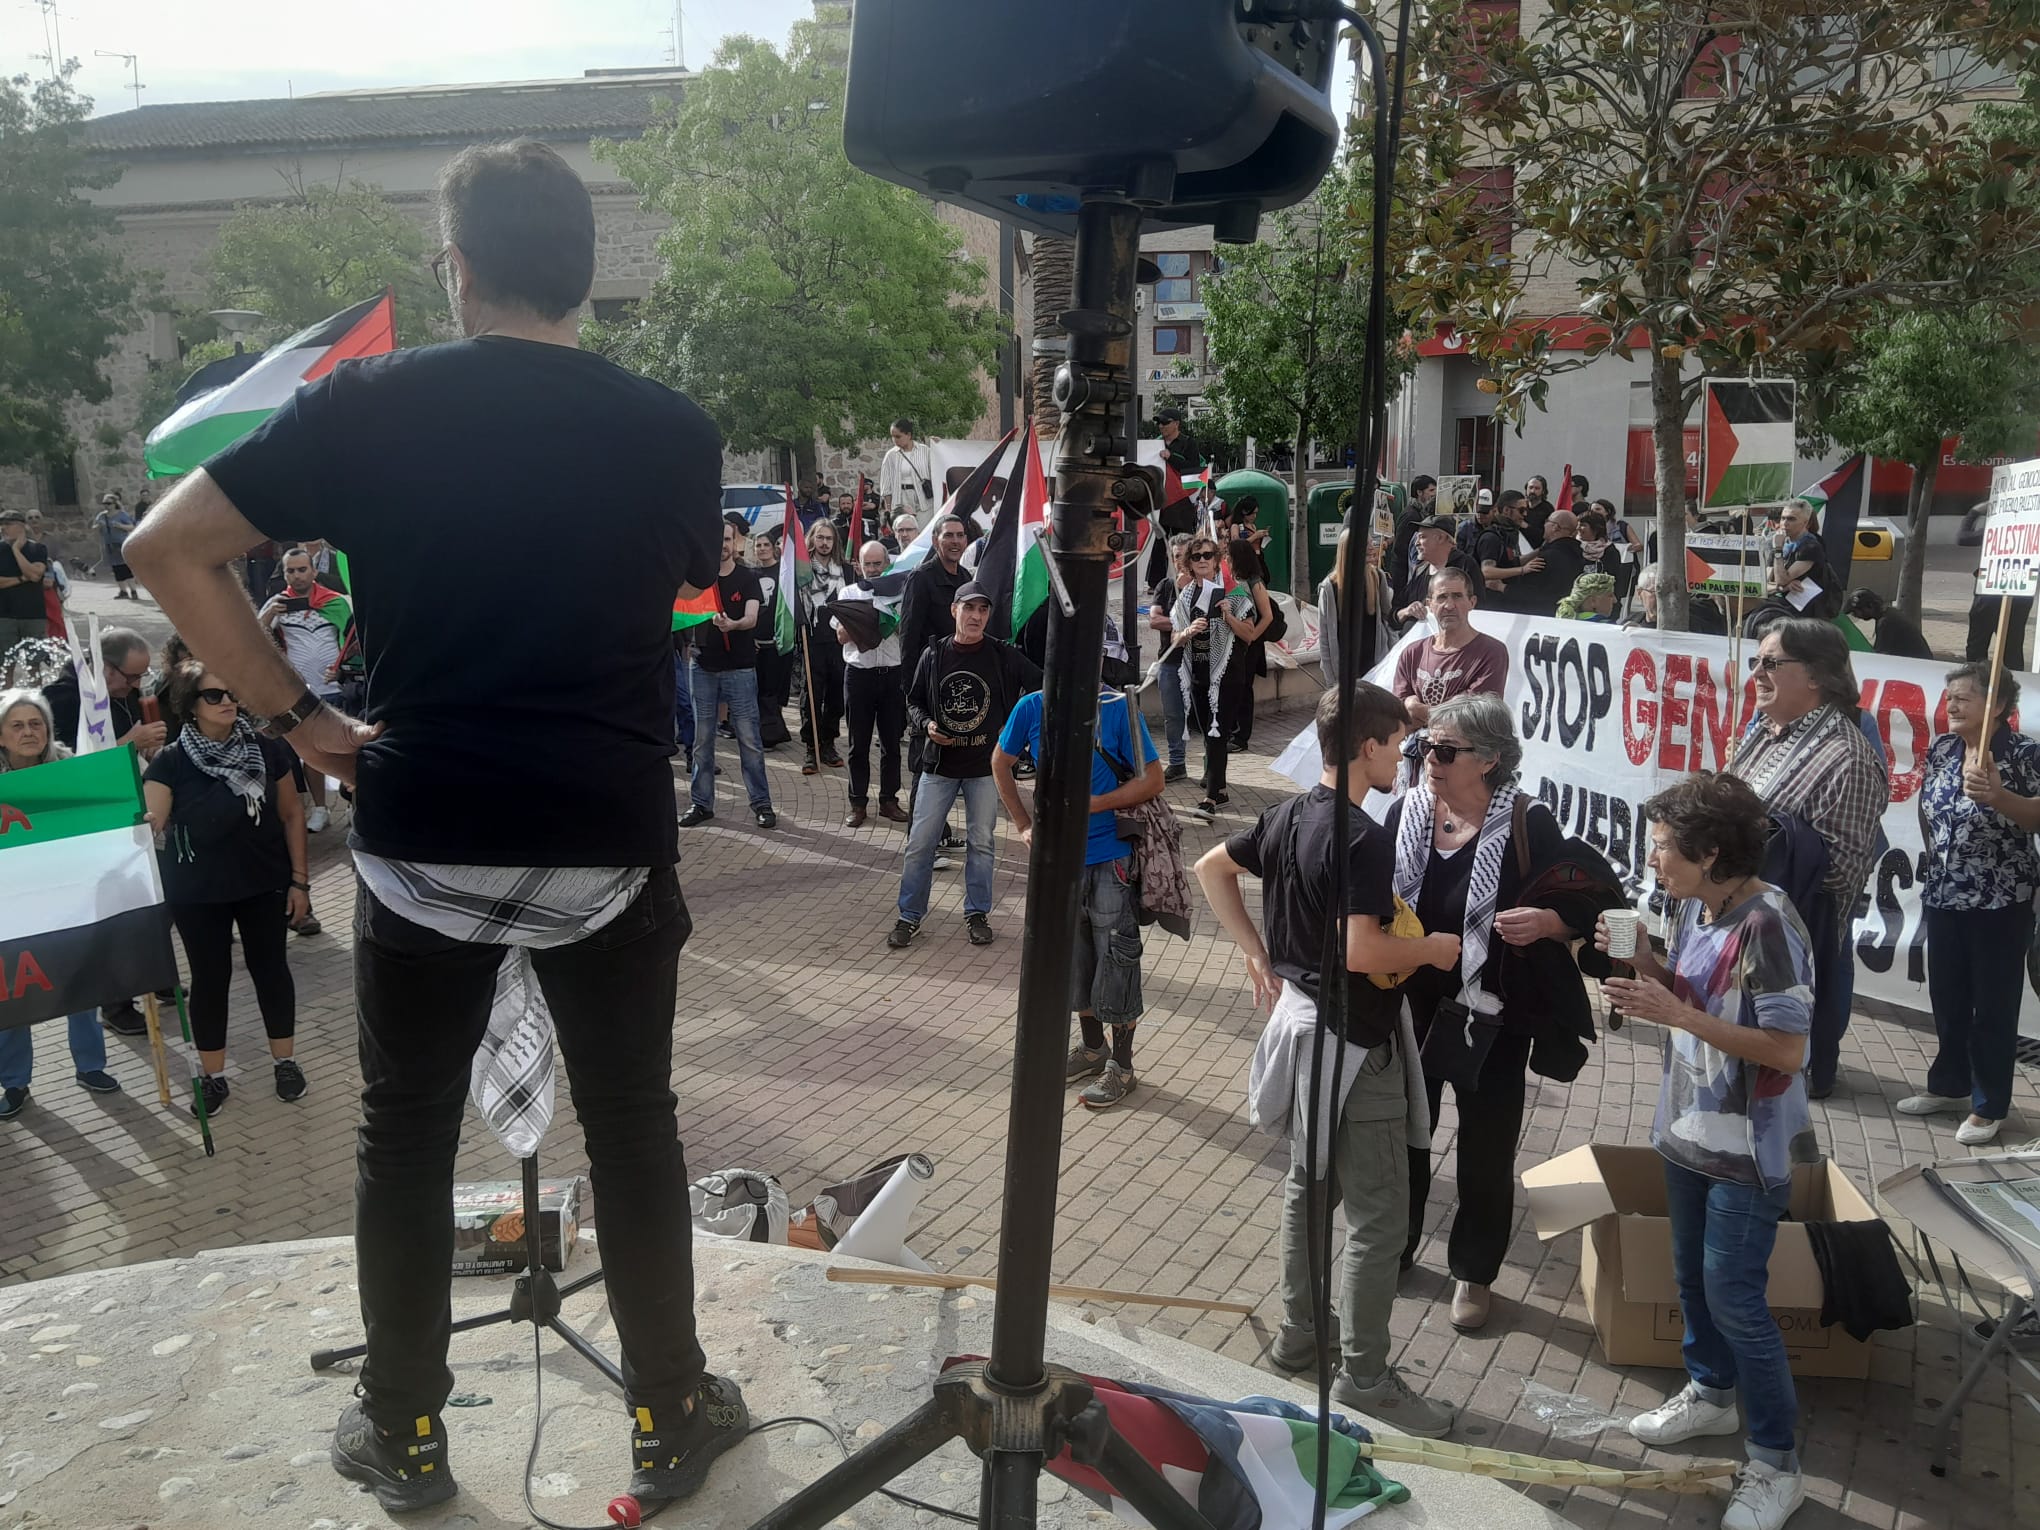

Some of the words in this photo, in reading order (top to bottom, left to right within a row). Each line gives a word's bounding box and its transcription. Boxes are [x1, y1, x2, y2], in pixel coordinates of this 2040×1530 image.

[1983, 523, 2040, 557] PALESTINA
[1709, 584, 1759, 595] PALESTNA
[1985, 558, 2030, 590] LIBRE
[1521, 632, 1612, 752] STOP
